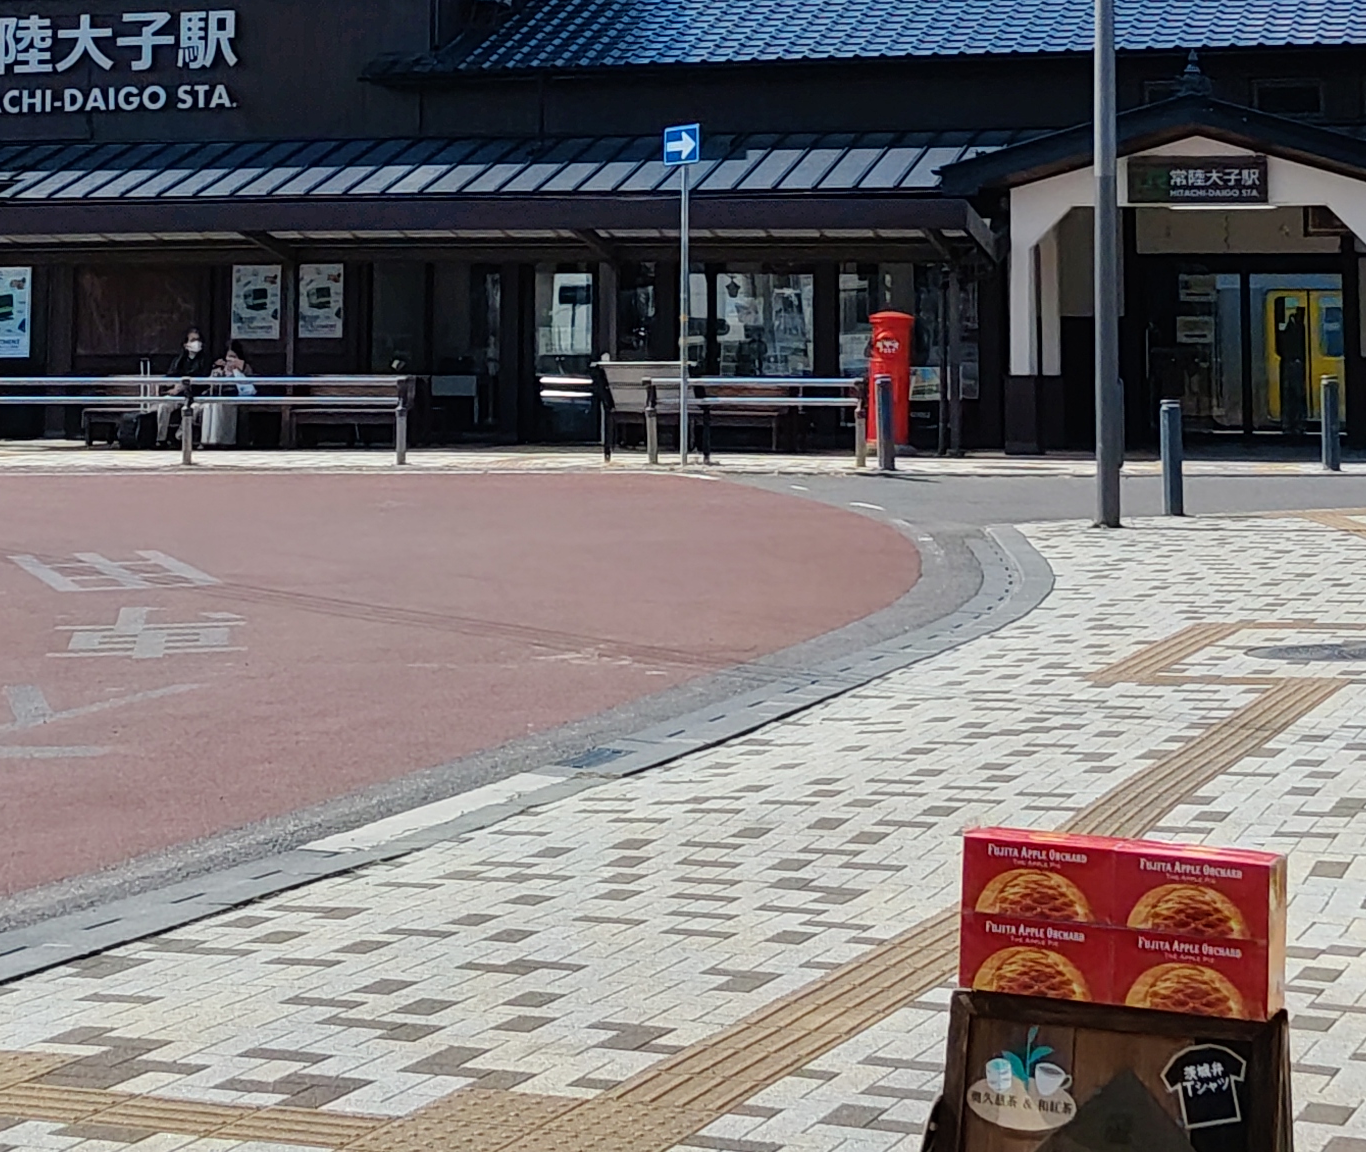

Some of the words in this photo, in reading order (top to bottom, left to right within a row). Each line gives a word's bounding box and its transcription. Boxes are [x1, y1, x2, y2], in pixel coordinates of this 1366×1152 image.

[176, 84, 239, 109] STA.
[1169, 168, 1260, 186] 常陸大子駅
[1169, 188, 1240, 198] HITACHI-DAIGO
[988, 843, 1019, 858] FUJITA
[1021, 846, 1047, 861] APPLE
[1049, 849, 1088, 863] ORCHARD
[1139, 857, 1172, 872] FUJITA
[1175, 861, 1201, 875] APPLE
[1203, 864, 1243, 879] ORCHARD
[985, 920, 1016, 935] FUJITA
[1018, 923, 1045, 938] APPLE
[1046, 927, 1086, 942] ORCHARD
[1138, 935, 1170, 951] FUJITA
[1172, 940, 1200, 954] APPLE
[1201, 943, 1243, 959] ORCHARD
[1183, 1061, 1225, 1081] 茨城弁
[1182, 1076, 1230, 1098] Tシャツ
[1022, 1098, 1032, 1110] &
